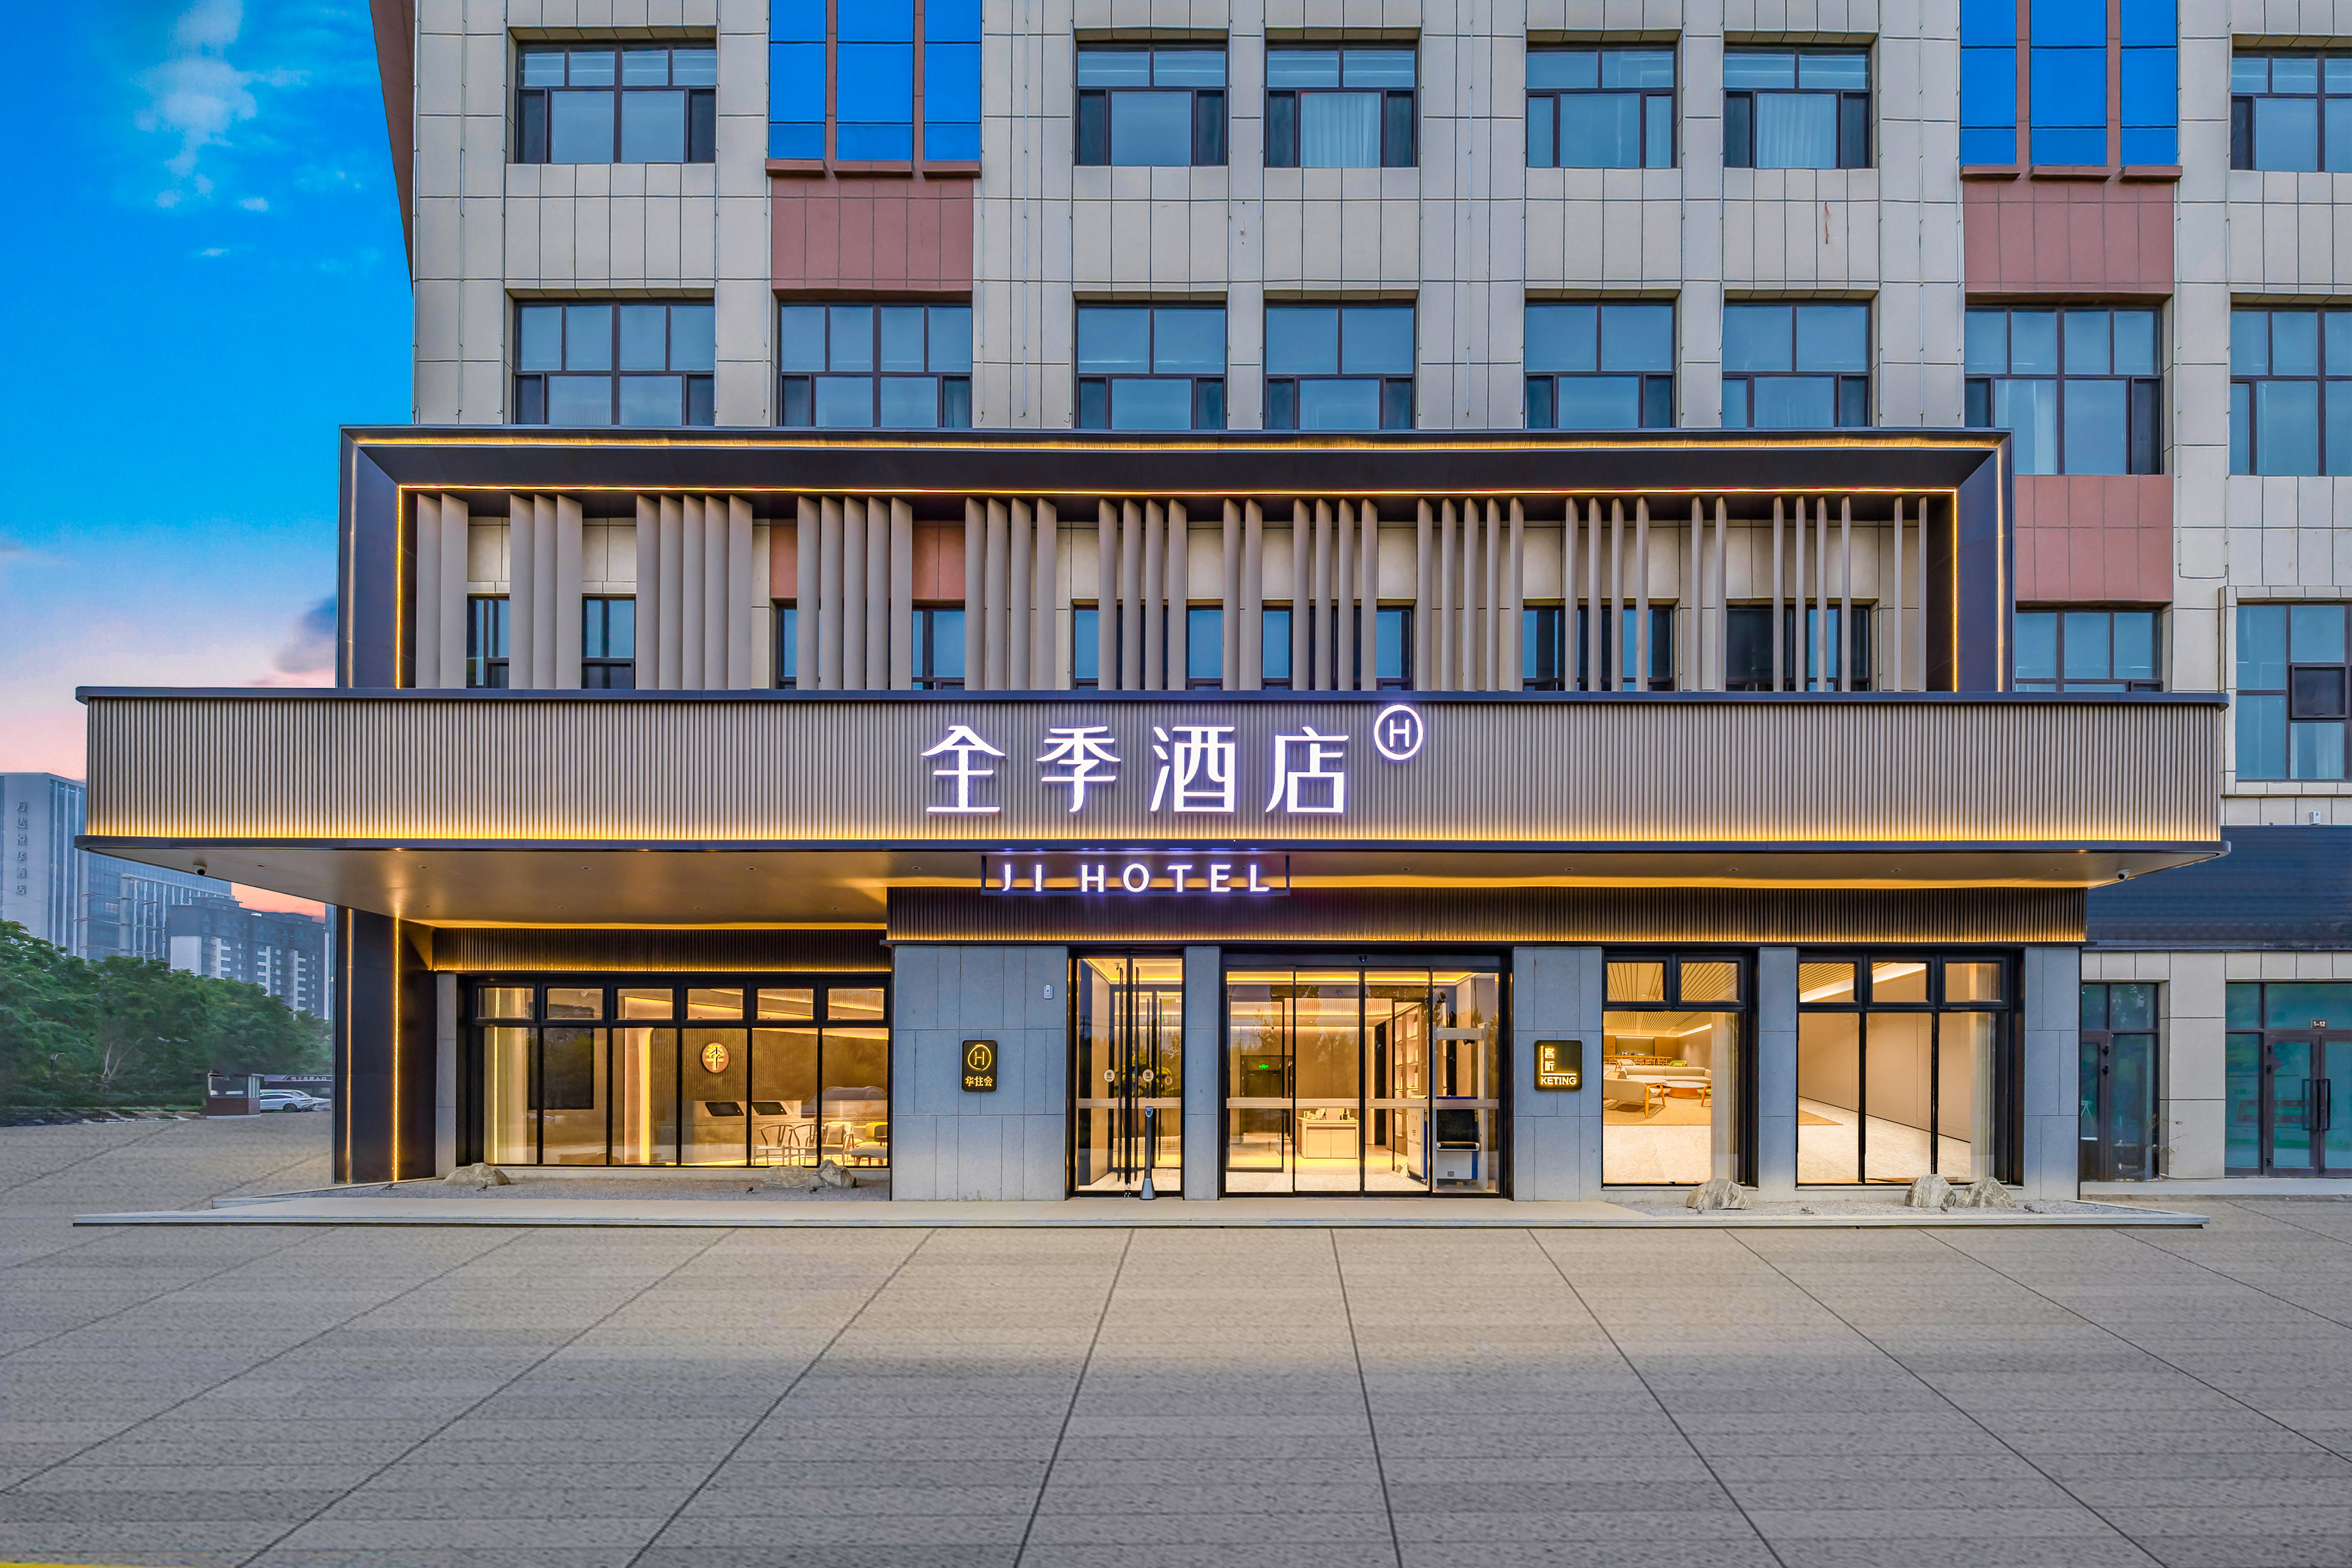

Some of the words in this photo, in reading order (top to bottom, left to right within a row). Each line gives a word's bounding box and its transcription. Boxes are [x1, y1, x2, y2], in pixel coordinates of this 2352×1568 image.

[920, 725, 1350, 813] 全季酒店
[1002, 864, 1043, 892] JI
[1081, 863, 1270, 893] HOTEL
[965, 1076, 993, 1087] 华住会
[1541, 1076, 1577, 1085] KETING
